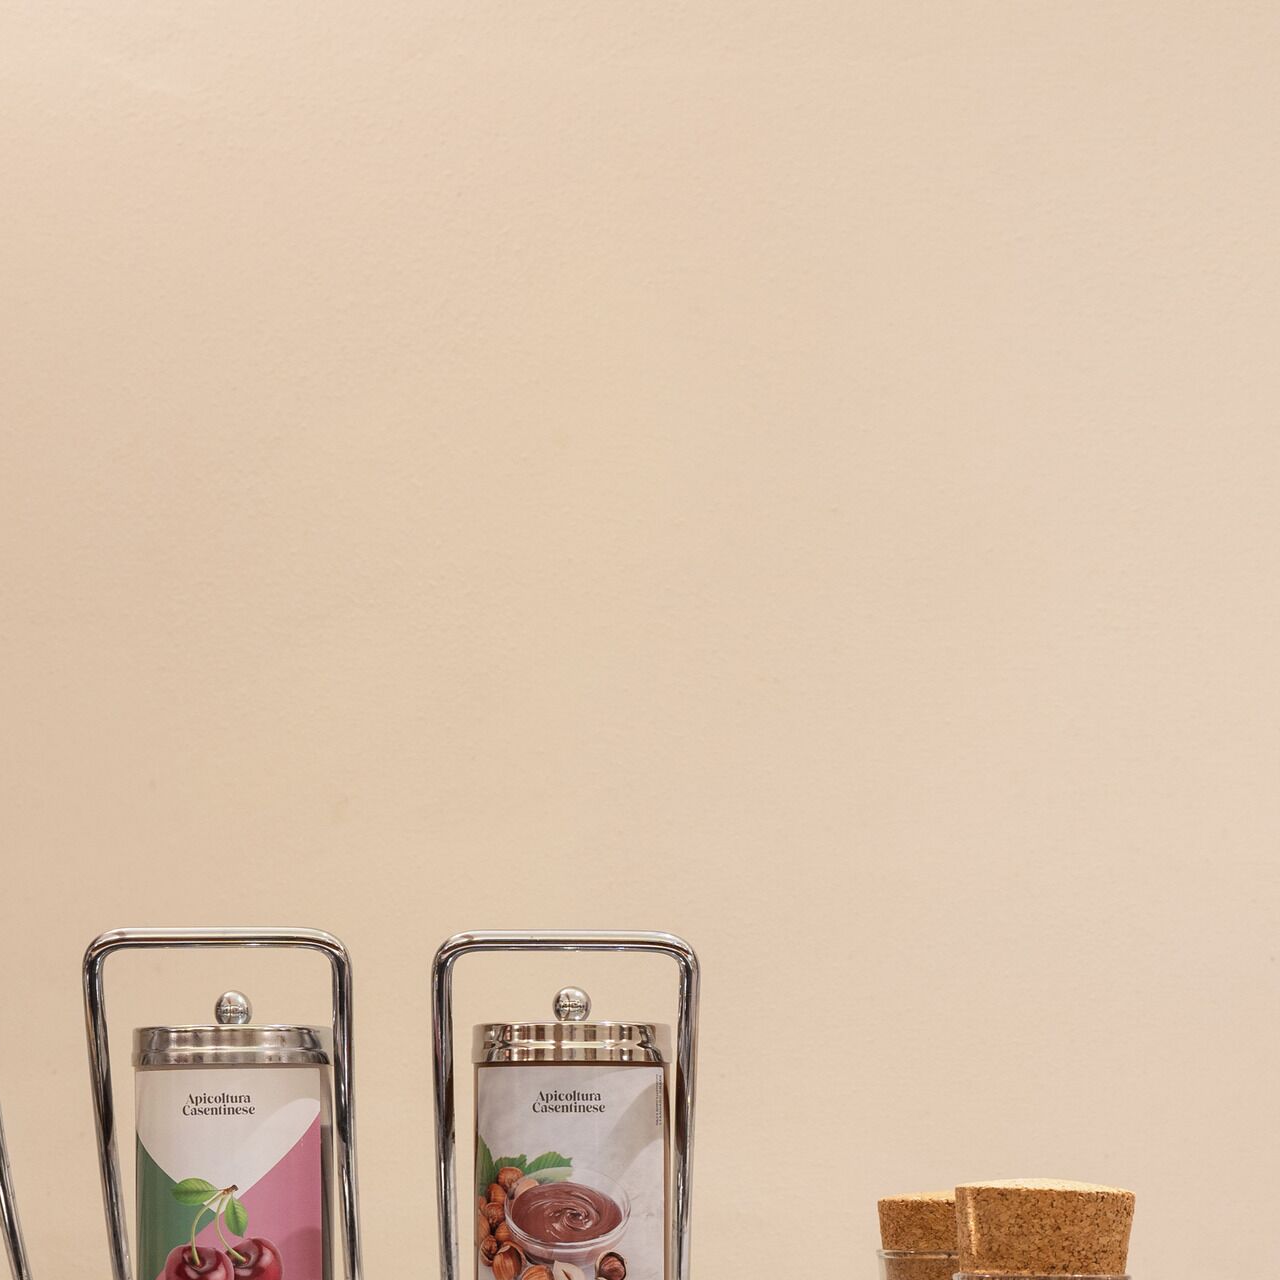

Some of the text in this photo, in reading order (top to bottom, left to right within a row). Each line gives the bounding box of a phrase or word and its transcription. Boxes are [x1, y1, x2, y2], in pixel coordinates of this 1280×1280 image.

[186, 1093, 251, 1106] Apicoltura
[536, 1090, 601, 1103] Apicoltura
[182, 1104, 256, 1116] Casentinese
[532, 1102, 606, 1113] Casentinese
